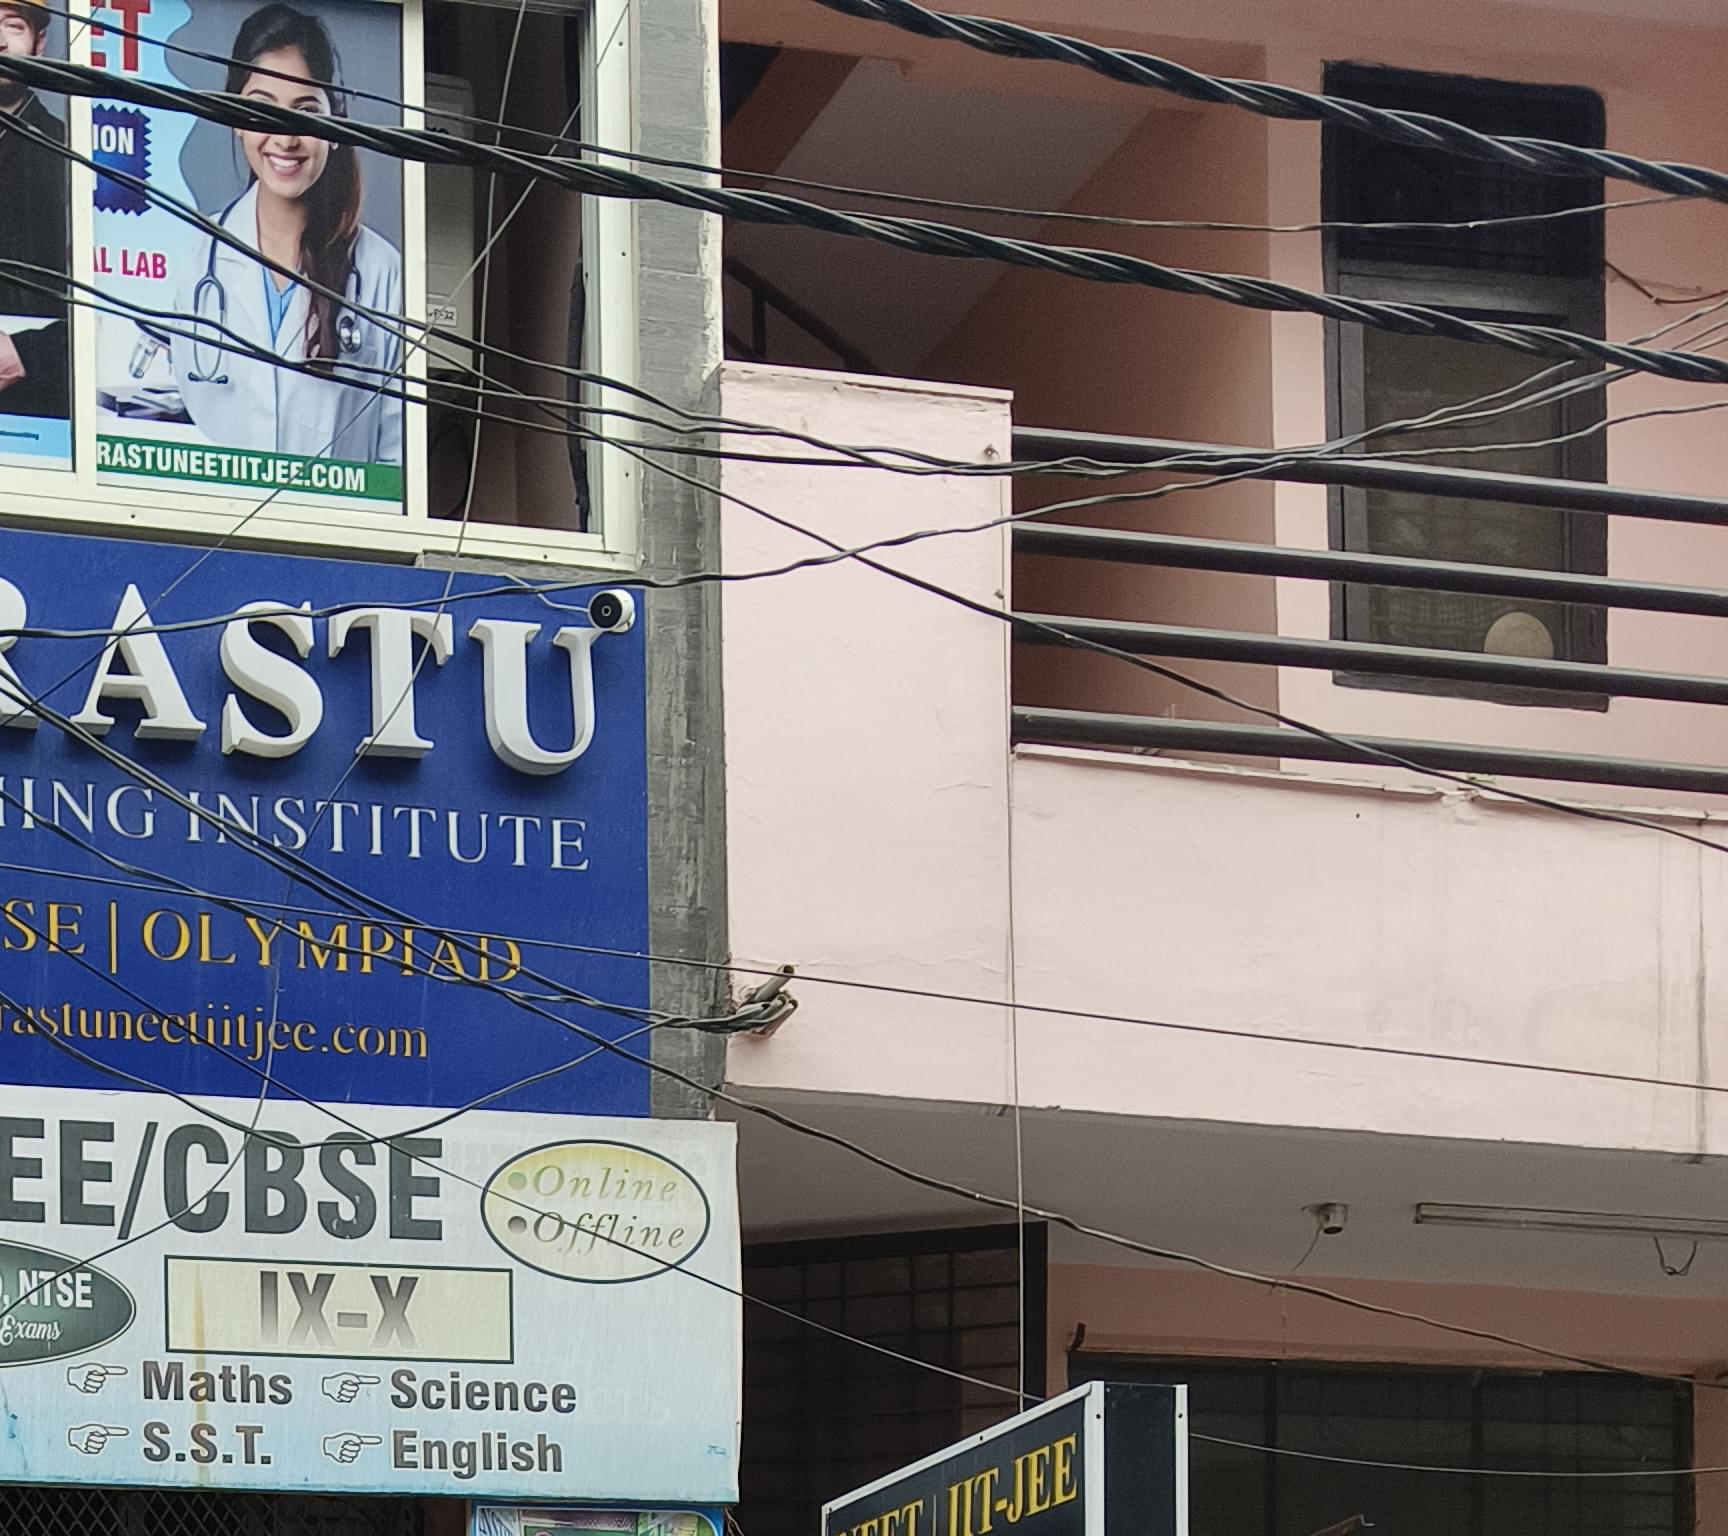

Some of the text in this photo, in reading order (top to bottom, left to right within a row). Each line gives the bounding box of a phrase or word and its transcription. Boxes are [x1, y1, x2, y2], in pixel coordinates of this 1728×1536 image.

[122, 249, 167, 280] LAB
[187, 791, 590, 872] INSTITUTE
[142, 908, 524, 985] OLYMPIAD
[533, 1164, 677, 1201] Online
[533, 1211, 685, 1256] Offline
[18, 1271, 94, 1309] NTSE
[259, 1270, 419, 1350] IX-X
[142, 1360, 578, 1416] Maths Science
[142, 1420, 564, 1475] S.S.T. English
